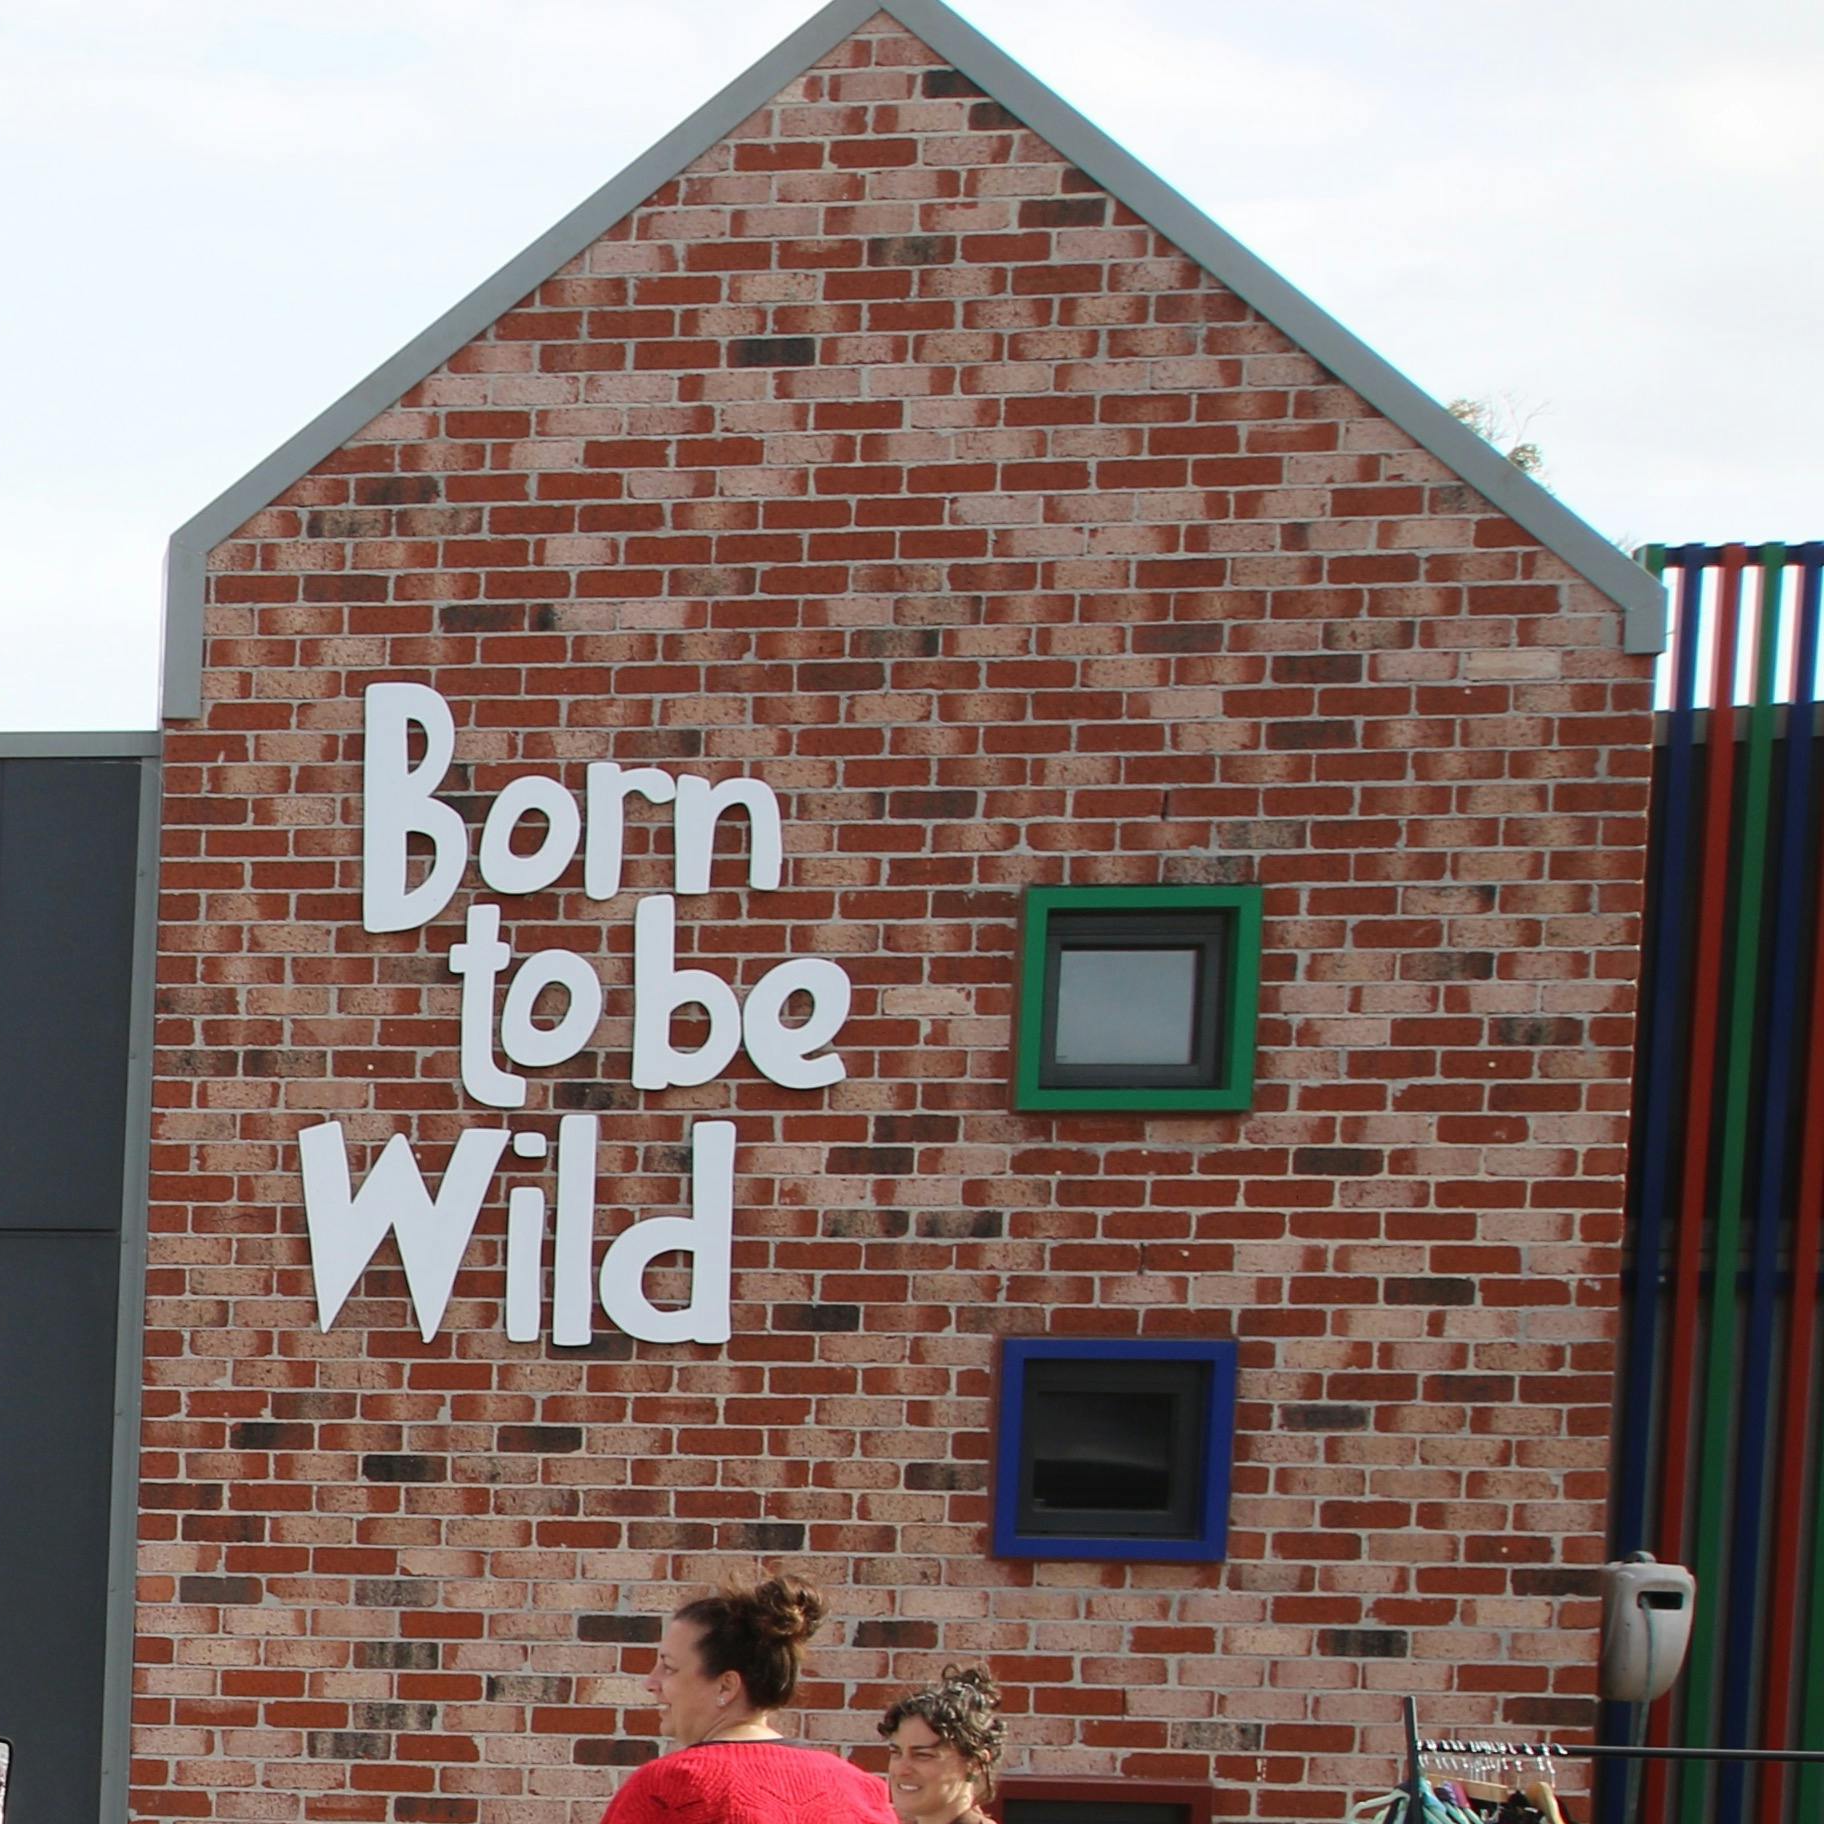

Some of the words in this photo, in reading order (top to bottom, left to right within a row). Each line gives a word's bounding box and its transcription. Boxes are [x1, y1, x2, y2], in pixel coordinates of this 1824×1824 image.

[364, 682, 782, 933] Born
[450, 904, 602, 1107] to
[632, 894, 852, 1090] be
[298, 1114, 736, 1347] Wild
